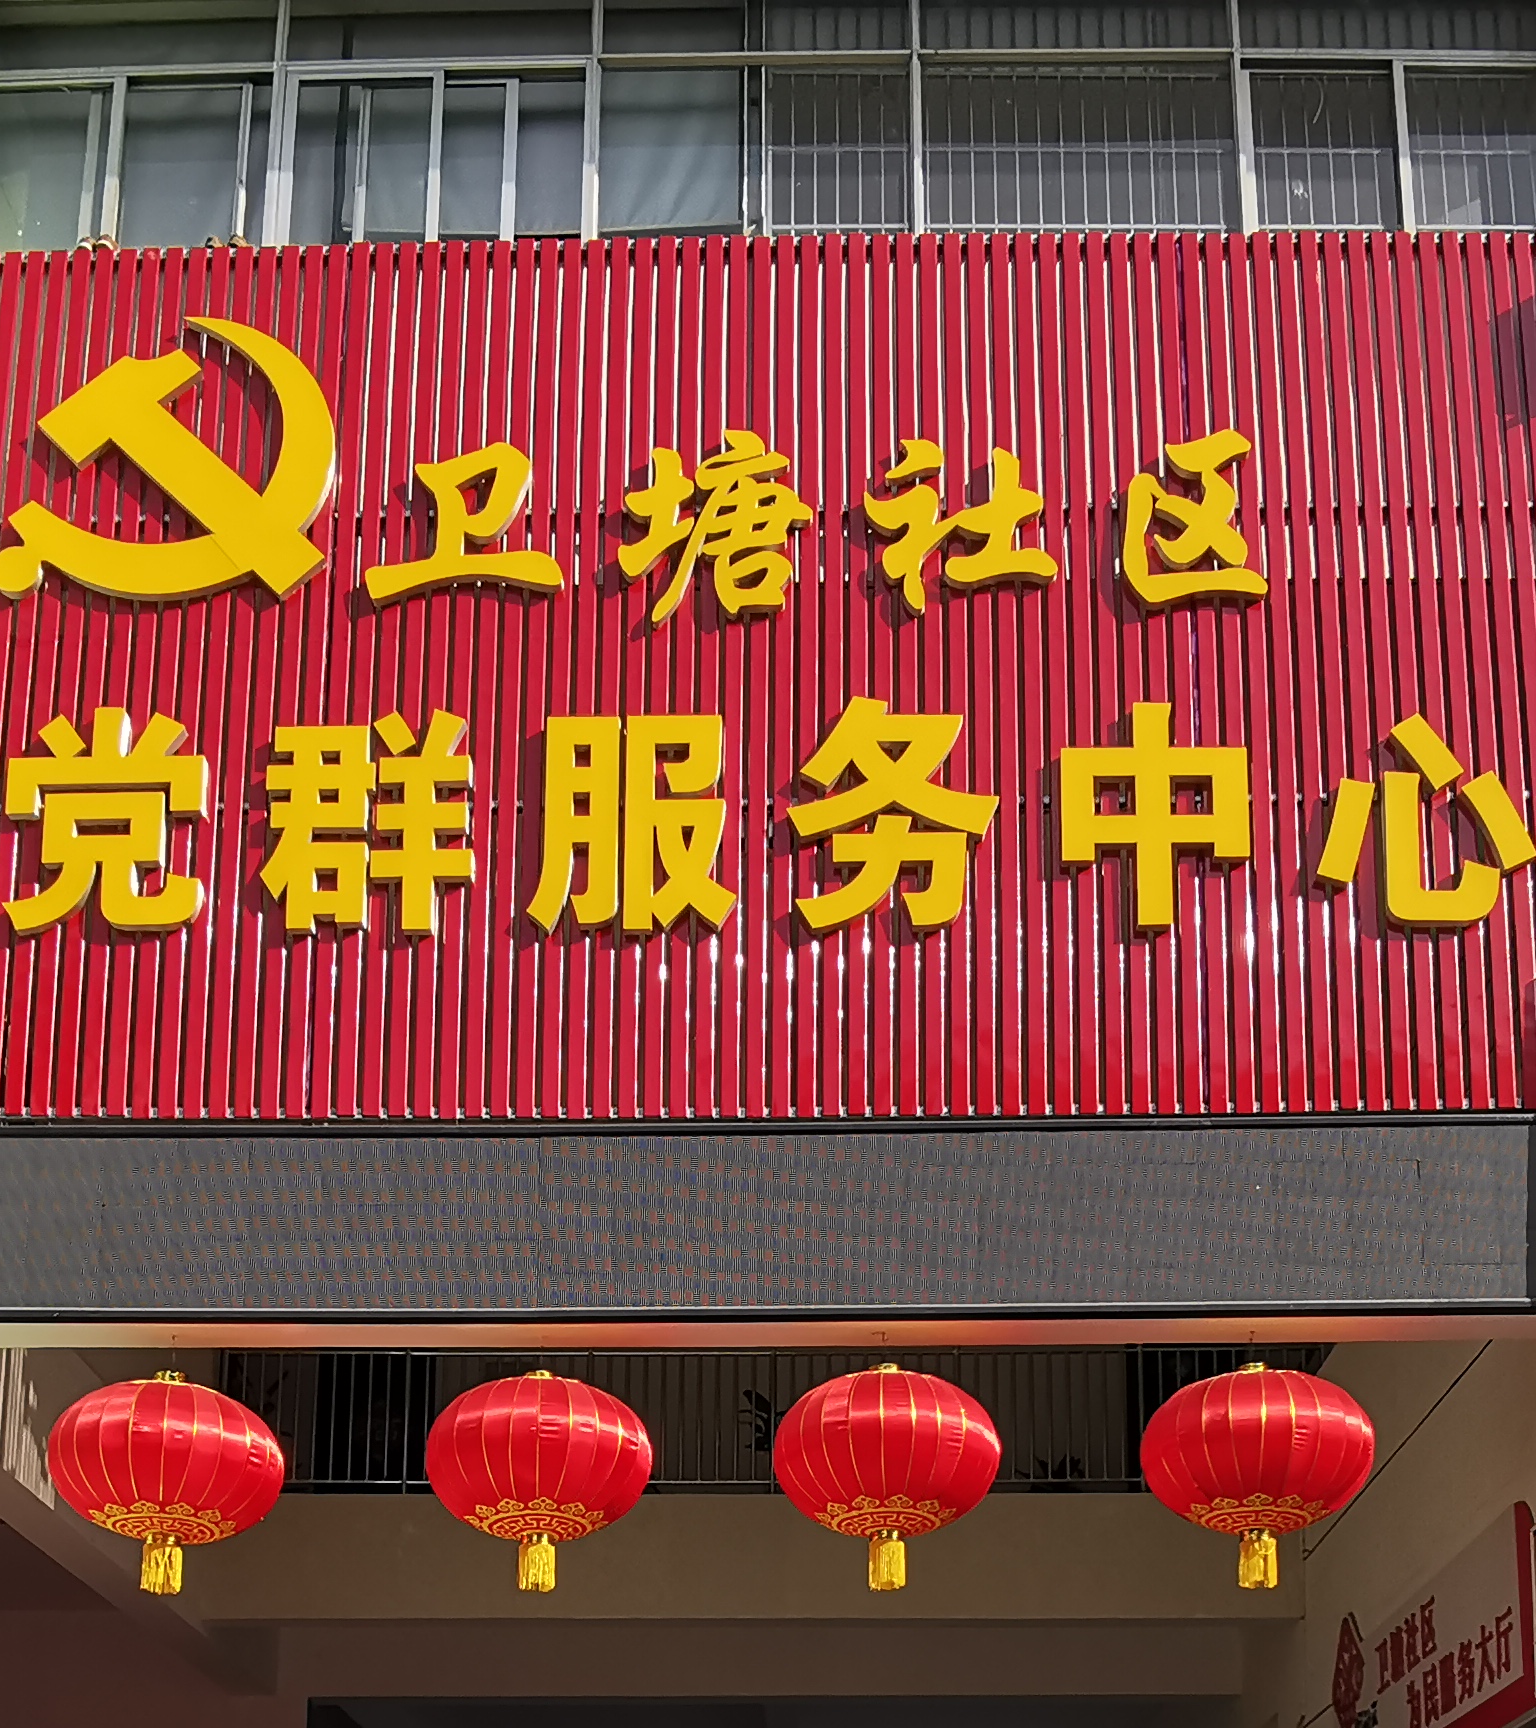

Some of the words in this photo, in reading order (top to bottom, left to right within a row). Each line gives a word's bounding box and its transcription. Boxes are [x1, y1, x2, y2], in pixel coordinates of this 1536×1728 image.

[365, 429, 1267, 622] 卫塘社区
[4, 697, 1536, 932] 党群服务中心
